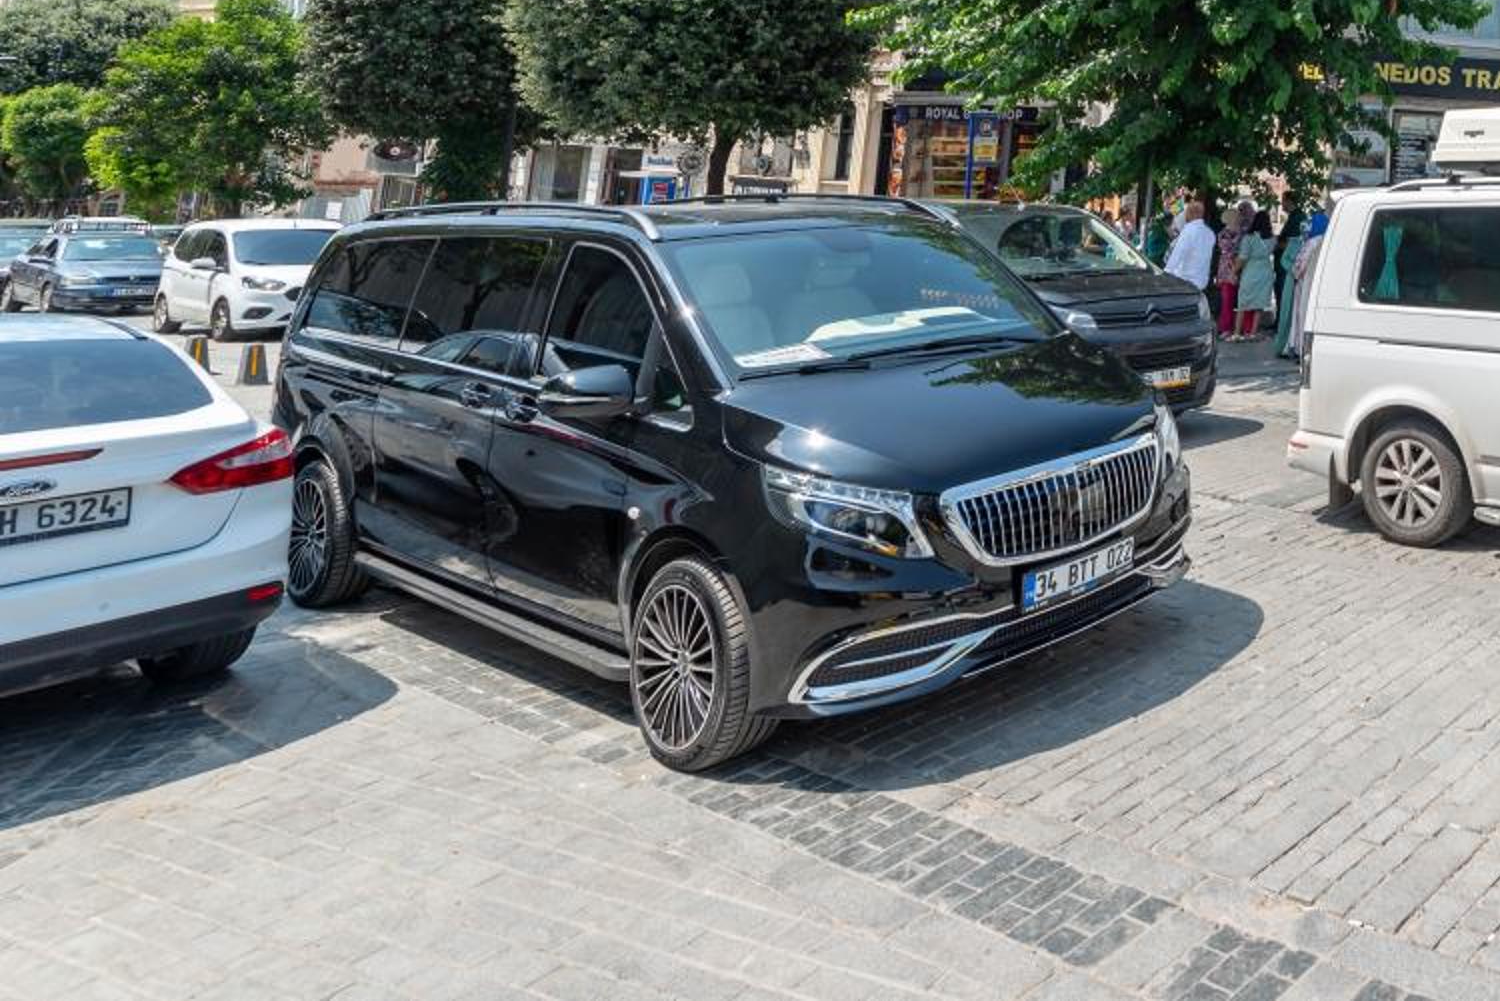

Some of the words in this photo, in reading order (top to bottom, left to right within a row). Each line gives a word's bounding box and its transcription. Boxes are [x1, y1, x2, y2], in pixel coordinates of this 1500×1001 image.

[925, 106, 960, 119] ROYAL
[38, 493, 117, 529] 6324
[1036, 572, 1057, 598] 34
[1068, 554, 1099, 586] BTT
[1106, 539, 1133, 570] 022
